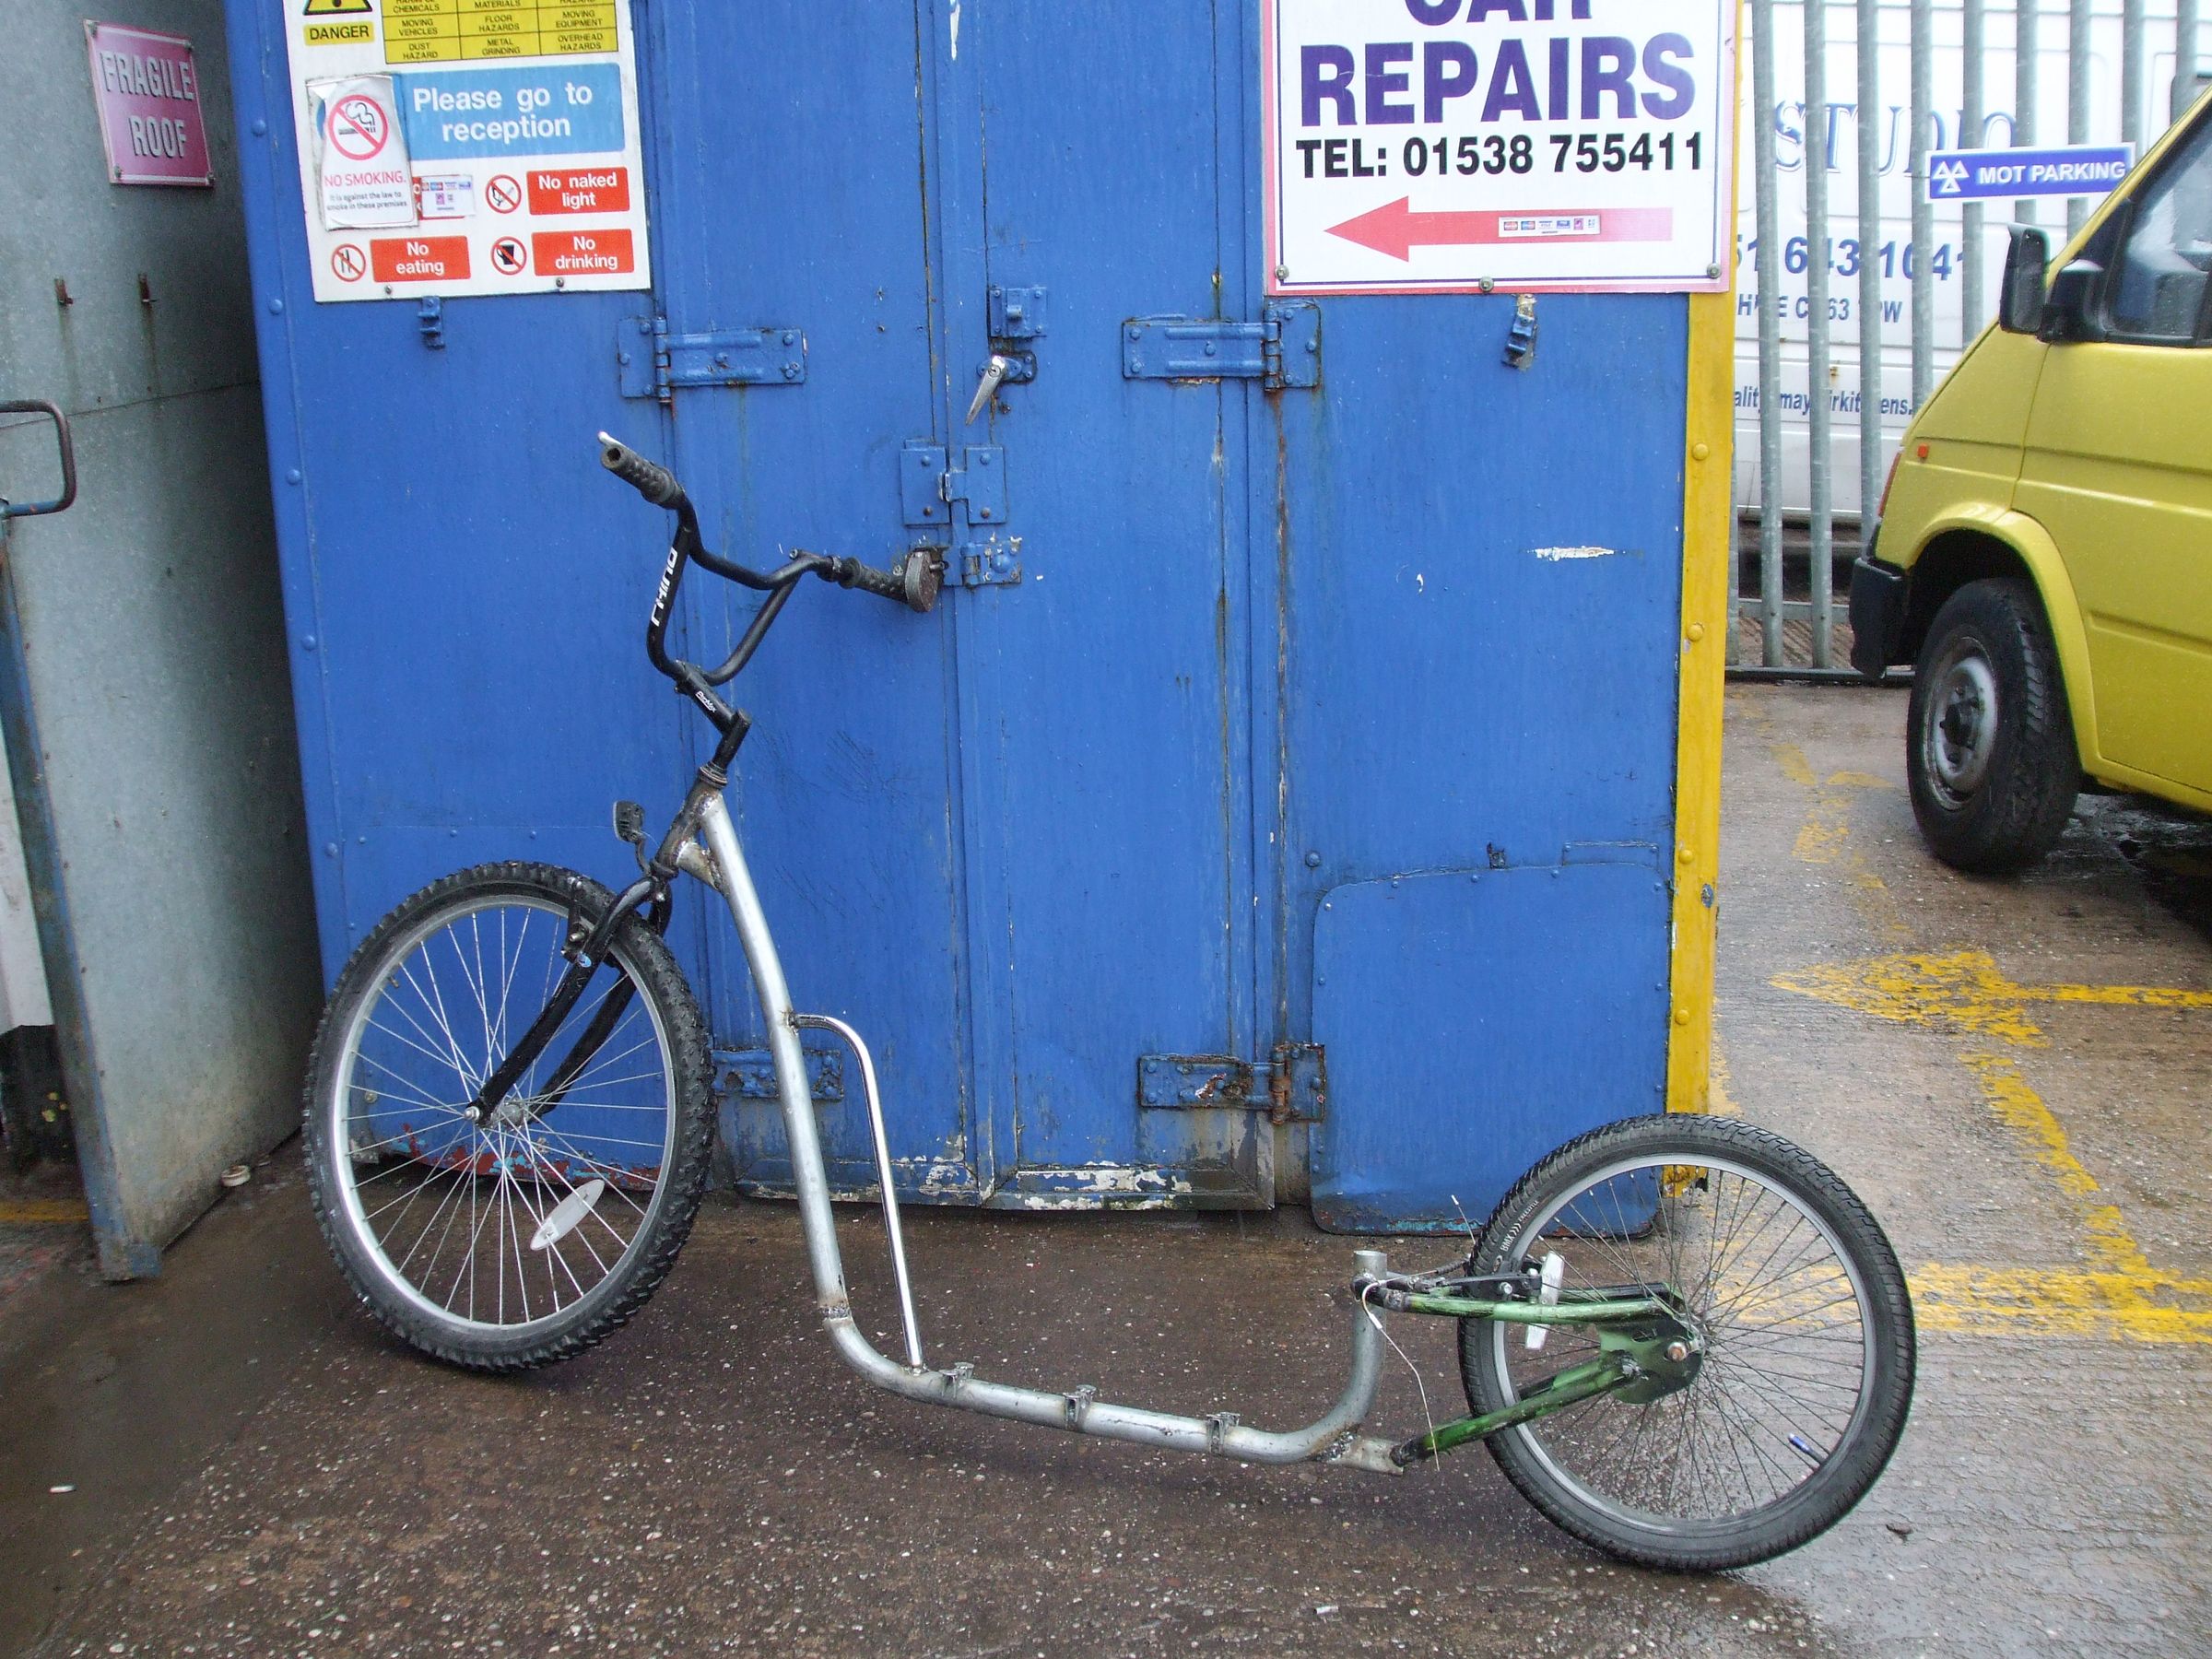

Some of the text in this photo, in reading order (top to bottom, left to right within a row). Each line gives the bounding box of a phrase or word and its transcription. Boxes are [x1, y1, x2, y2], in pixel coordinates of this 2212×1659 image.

[394, 4, 440, 13] CHEMICALS
[562, 10, 594, 18] MOVING
[402, 18, 433, 27] MOVING
[485, 14, 512, 23] FLOOR
[556, 18, 603, 28] EQUIPMENT
[310, 25, 370, 41] DANGER
[399, 27, 438, 36] VEHICLES
[479, 23, 520, 31] HAZARDS
[487, 38, 513, 46] METAL
[558, 32, 603, 42] OVERHEAD
[409, 42, 430, 51] DUST
[482, 47, 520, 55] GRINDING
[560, 42, 601, 52] HAZARDS
[403, 51, 438, 60] HAZARD
[100, 51, 194, 100] FRAGILE
[1300, 32, 1697, 126] REPAIRS
[413, 81, 593, 112] Please go to
[442, 114, 571, 145] reception
[128, 115, 187, 158] ROOF
[1296, 131, 1701, 179] TEL: 01538 755411
[1980, 161, 2125, 184] MOT PARKING
[324, 175, 342, 187] NO
[538, 171, 618, 190] No naked
[344, 194, 368, 202] against
[562, 192, 596, 209] light
[376, 201, 407, 210] premises
[406, 241, 429, 256] No
[573, 236, 595, 251] No
[555, 253, 618, 270] drinking
[1785, 236, 1860, 276] 63
[1878, 241, 1964, 281] 104
[395, 259, 444, 276] eating
[1500, 1233, 1516, 1252] BMX
